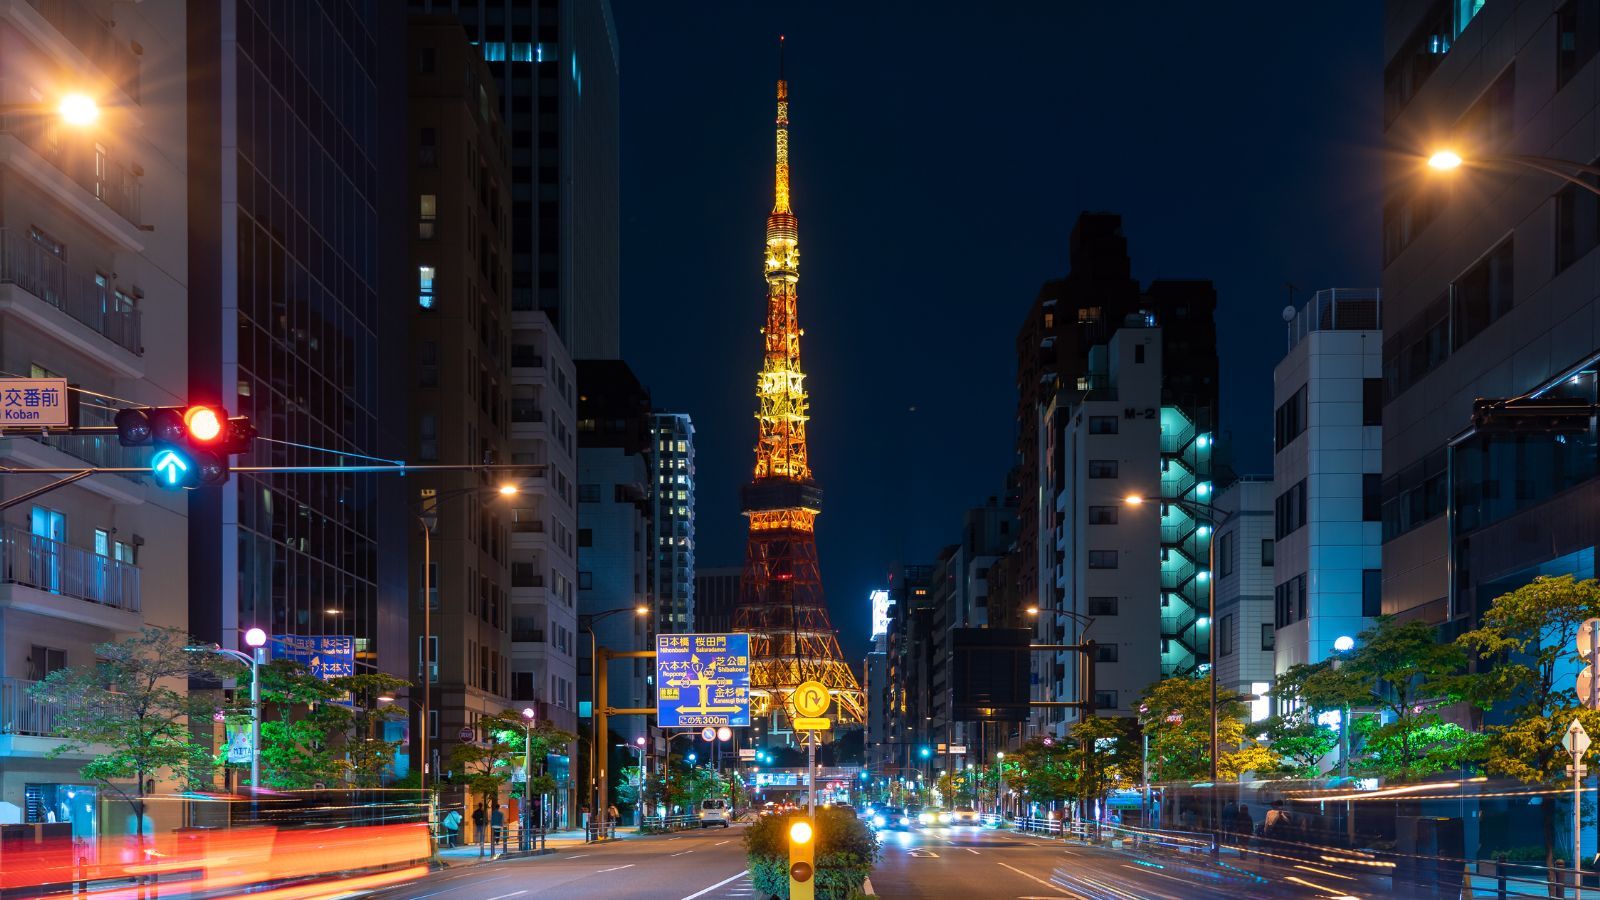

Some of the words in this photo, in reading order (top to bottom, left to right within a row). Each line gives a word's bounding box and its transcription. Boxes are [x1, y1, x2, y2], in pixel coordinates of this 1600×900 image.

[0, 387, 59, 407] 交番前
[5, 409, 39, 420] Koban
[1124, 408, 1156, 420] M-2
[659, 637, 690, 647] 日本橋
[695, 636, 727, 647] 桜田門
[659, 661, 690, 671] 六本木
[716, 656, 747, 666] 芝公園
[680, 716, 728, 725] この先300m
[233, 747, 252, 756] MITA
